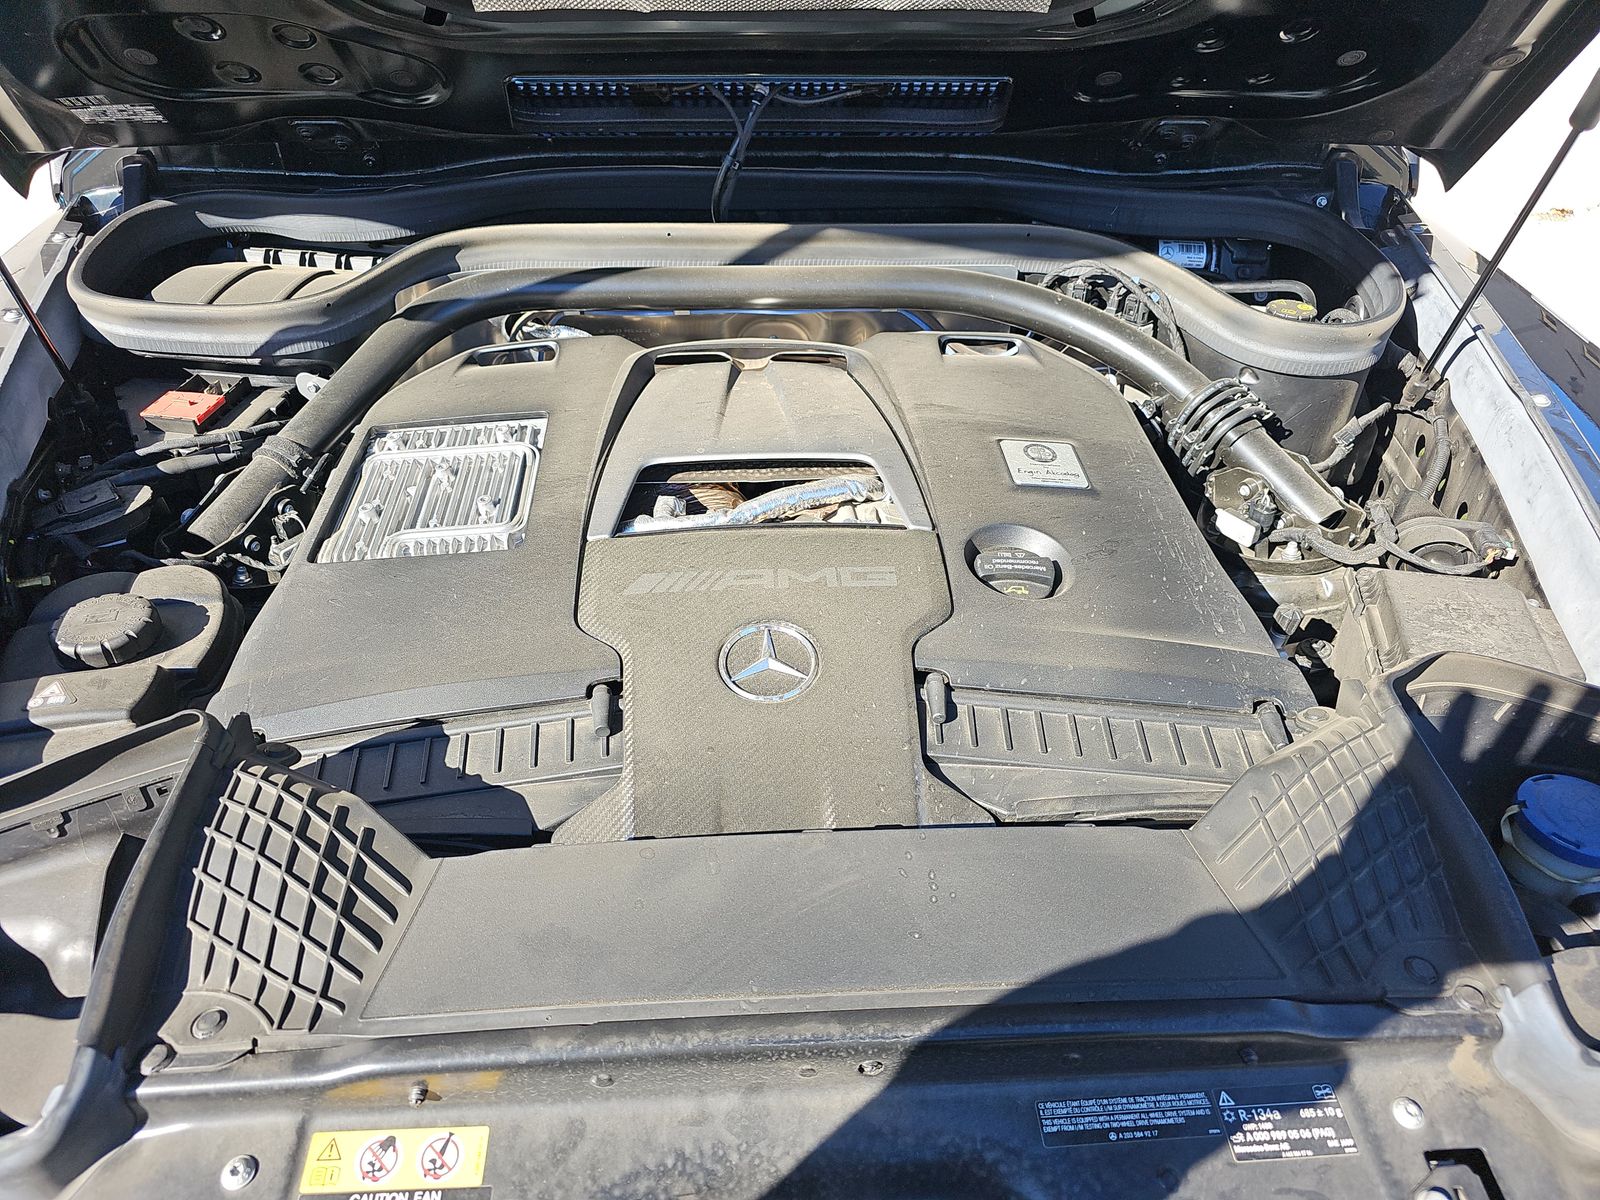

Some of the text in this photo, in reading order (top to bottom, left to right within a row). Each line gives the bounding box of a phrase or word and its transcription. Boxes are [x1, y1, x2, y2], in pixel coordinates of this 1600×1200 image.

[711, 567, 897, 590] AMG
[1114, 1113, 1140, 1121] PERMANENT
[1238, 1107, 1282, 1122] R-134a
[1324, 1107, 1335, 1116] 10
[349, 1190, 442, 1200] CAUTION FAN
